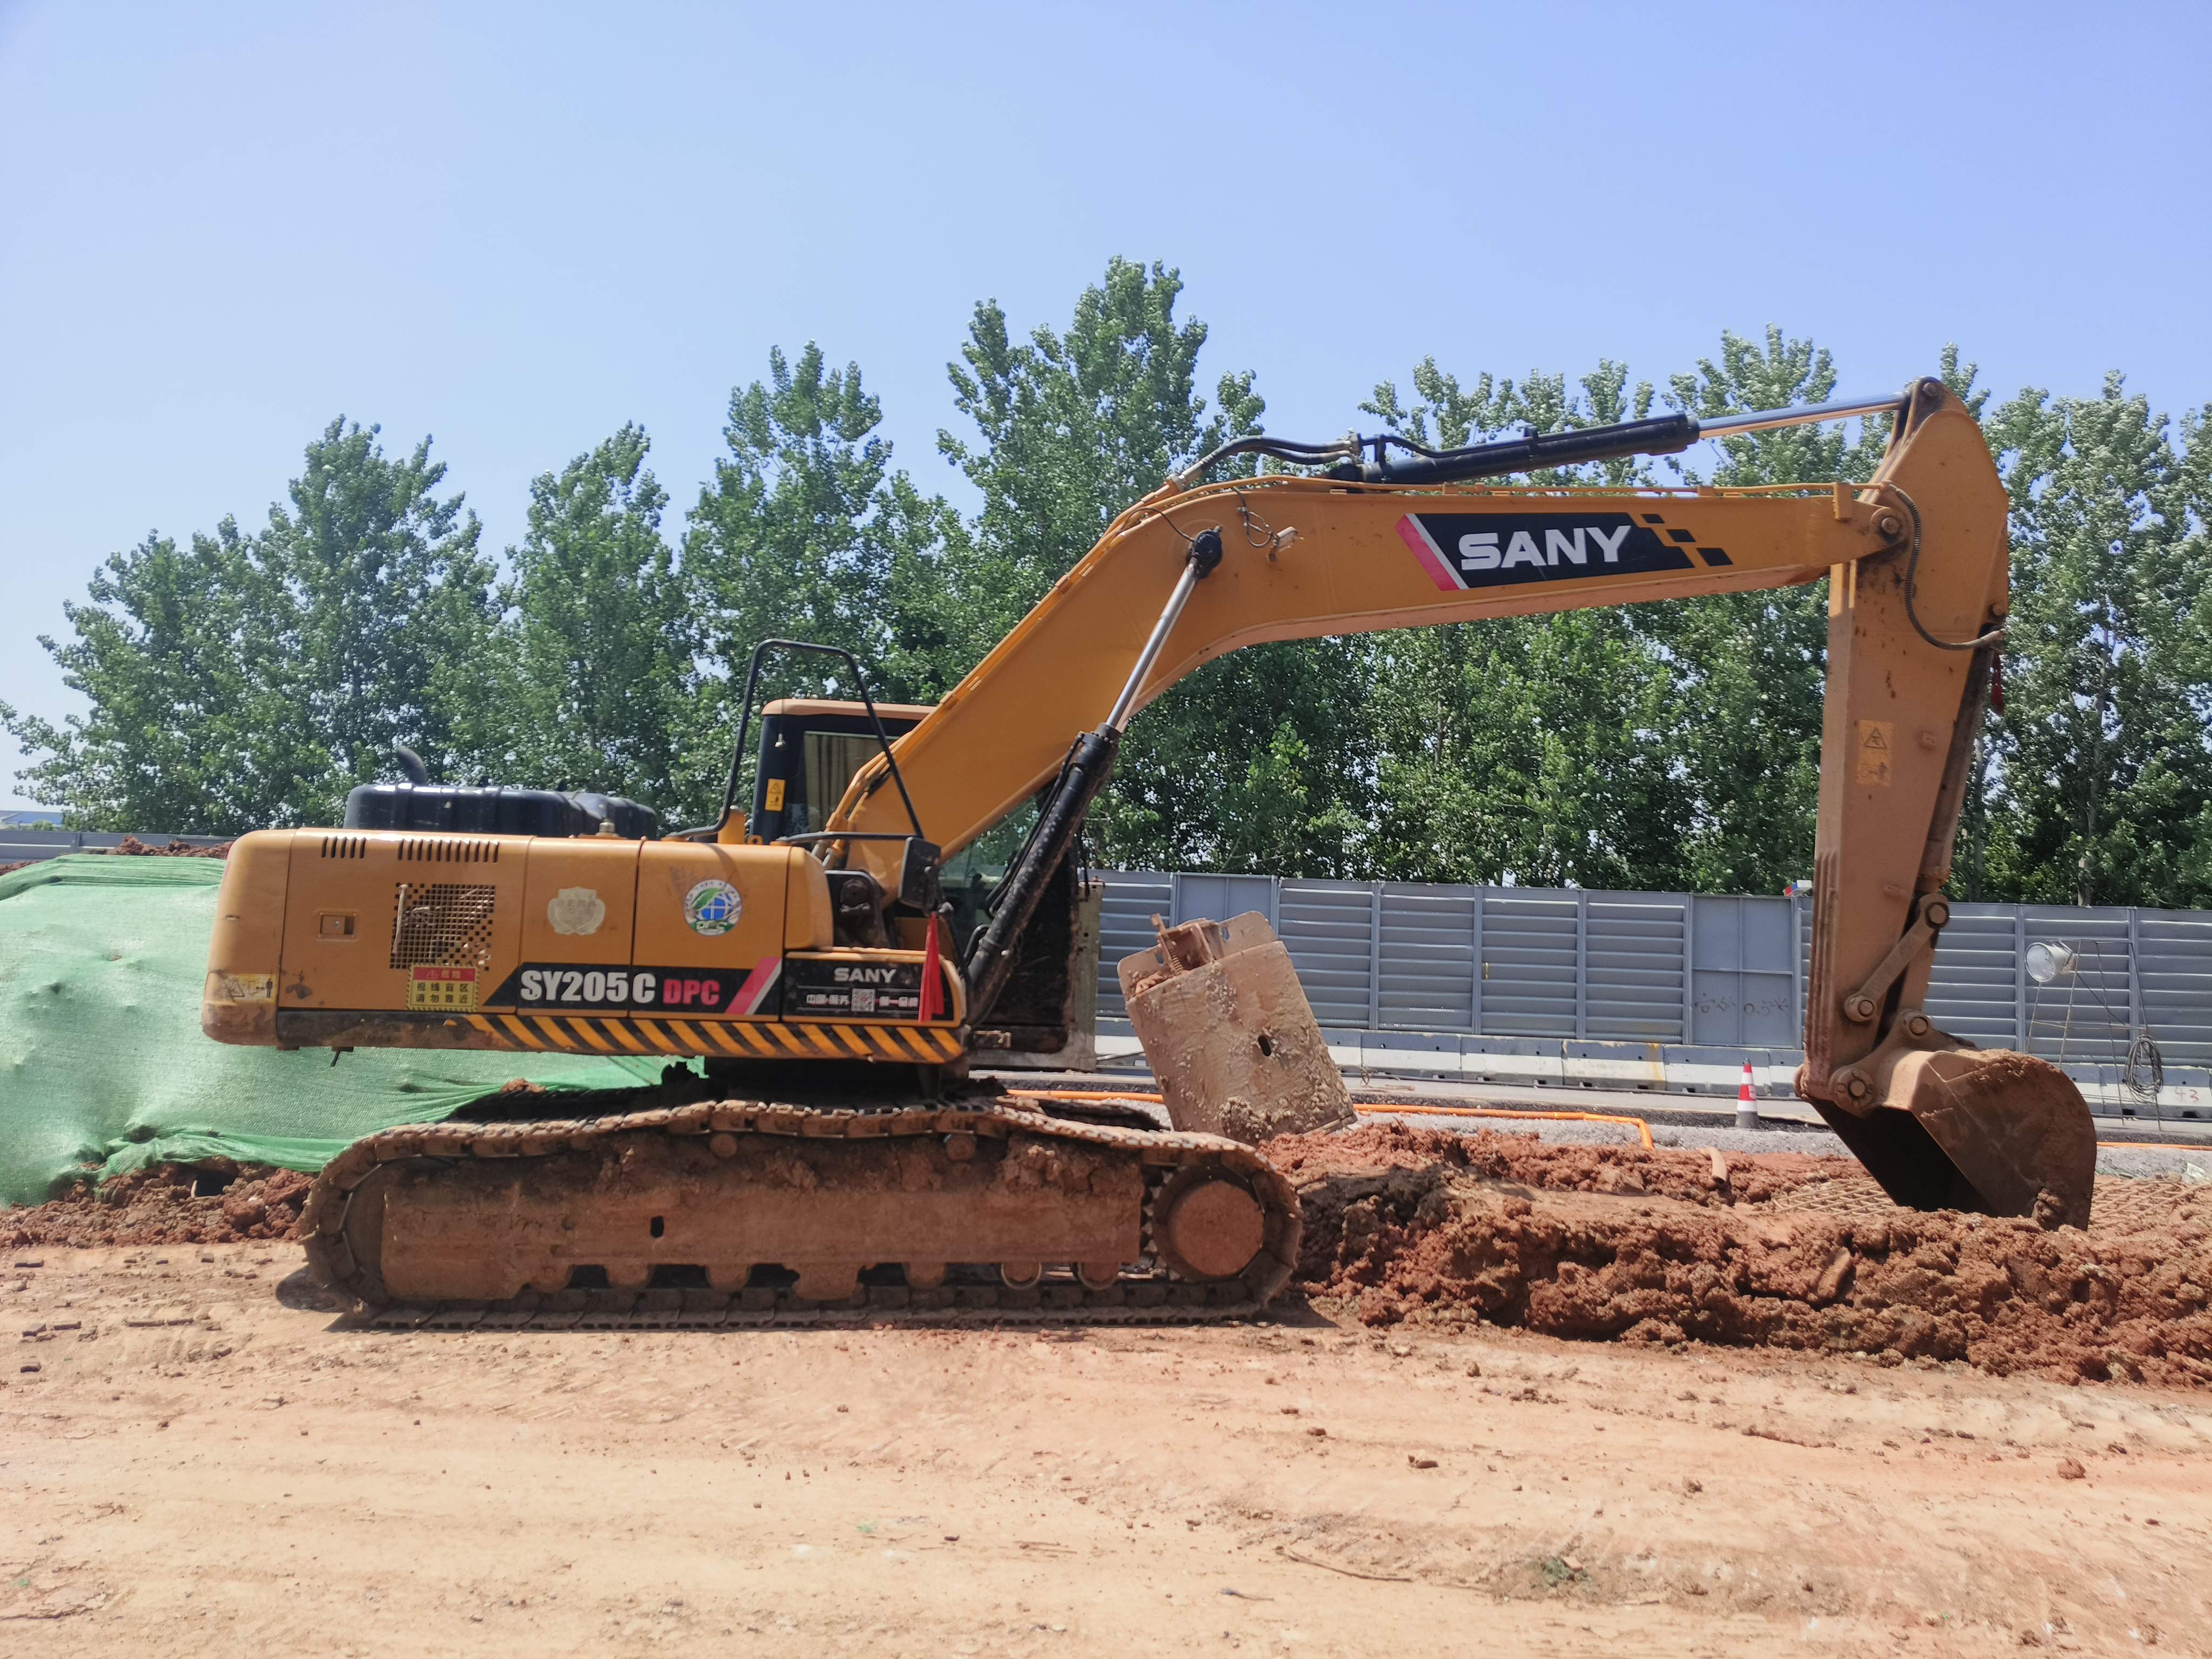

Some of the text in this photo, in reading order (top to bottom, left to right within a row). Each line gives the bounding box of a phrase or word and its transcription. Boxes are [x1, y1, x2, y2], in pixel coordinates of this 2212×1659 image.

[1459, 525, 1631, 570] SANY
[834, 967, 896, 983] SANY
[663, 979, 720, 1005] DPC
